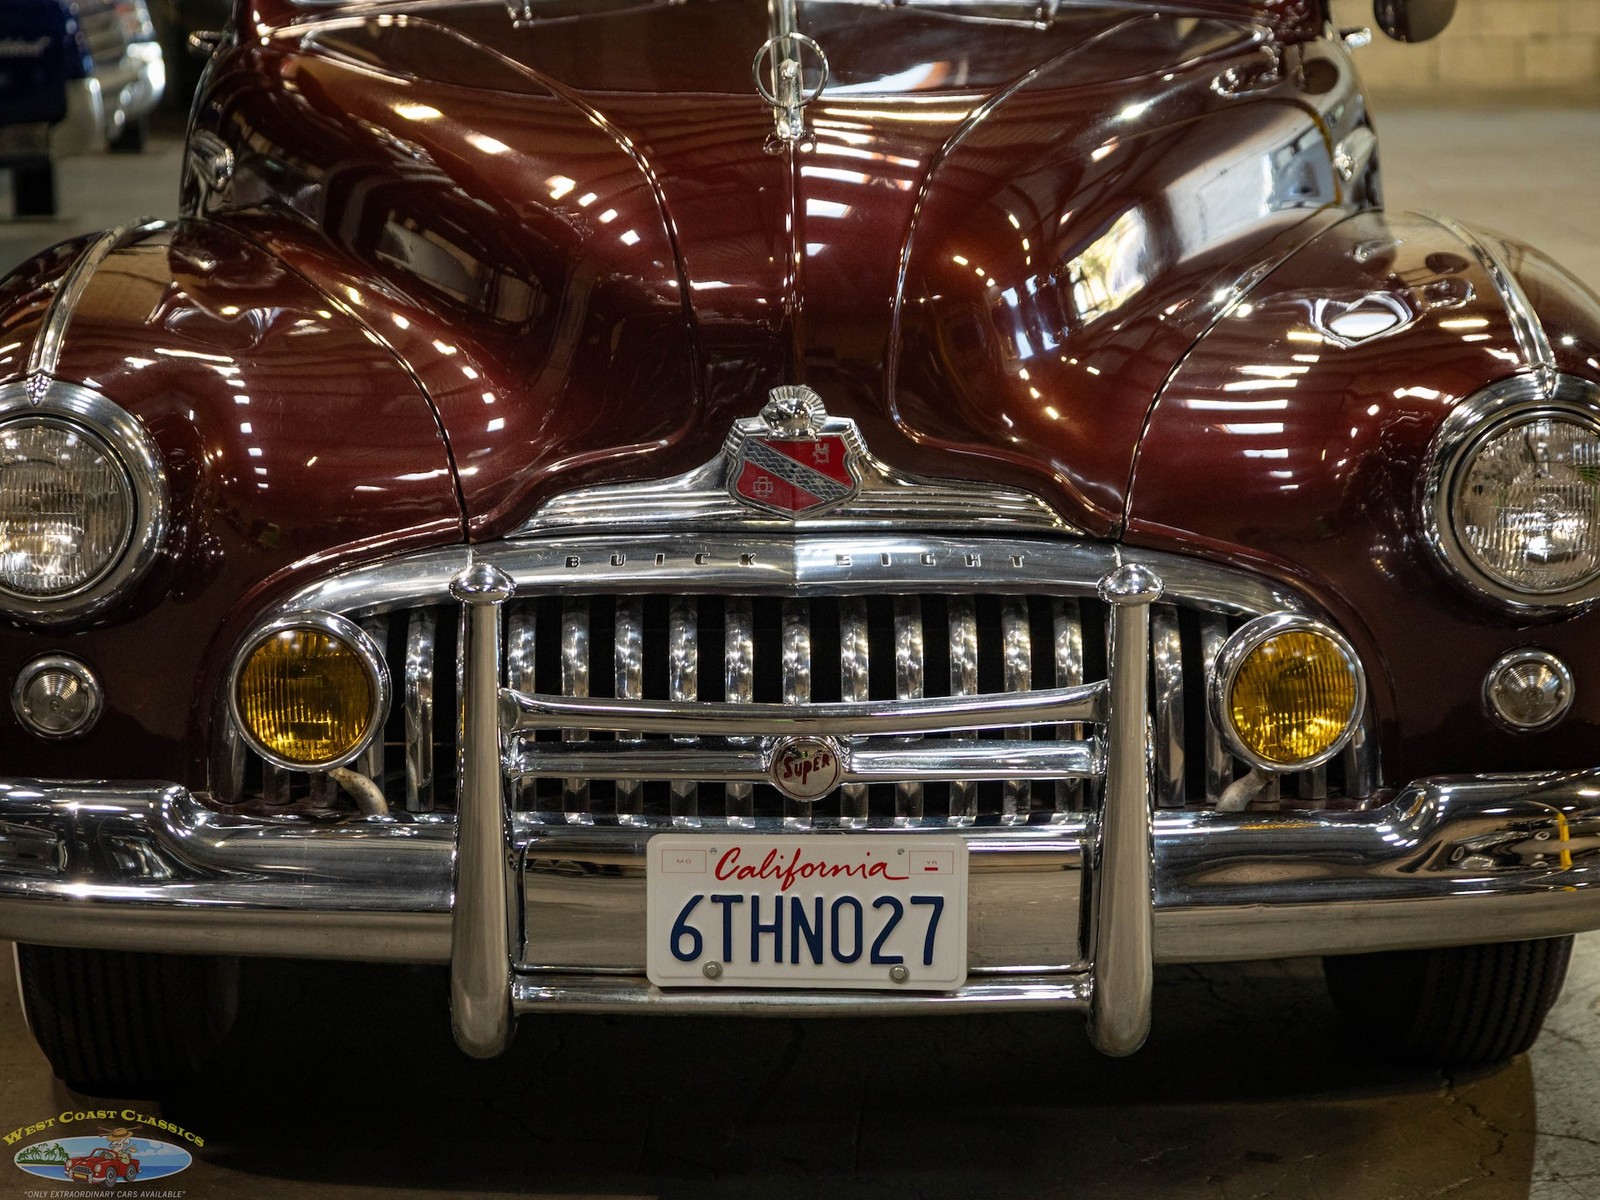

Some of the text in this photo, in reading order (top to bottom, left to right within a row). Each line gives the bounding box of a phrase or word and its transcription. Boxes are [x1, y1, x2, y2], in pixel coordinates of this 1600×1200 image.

[565, 552, 1025, 569] BUICK EIGHT
[714, 846, 909, 891] California
[669, 894, 945, 965] 6THN027
